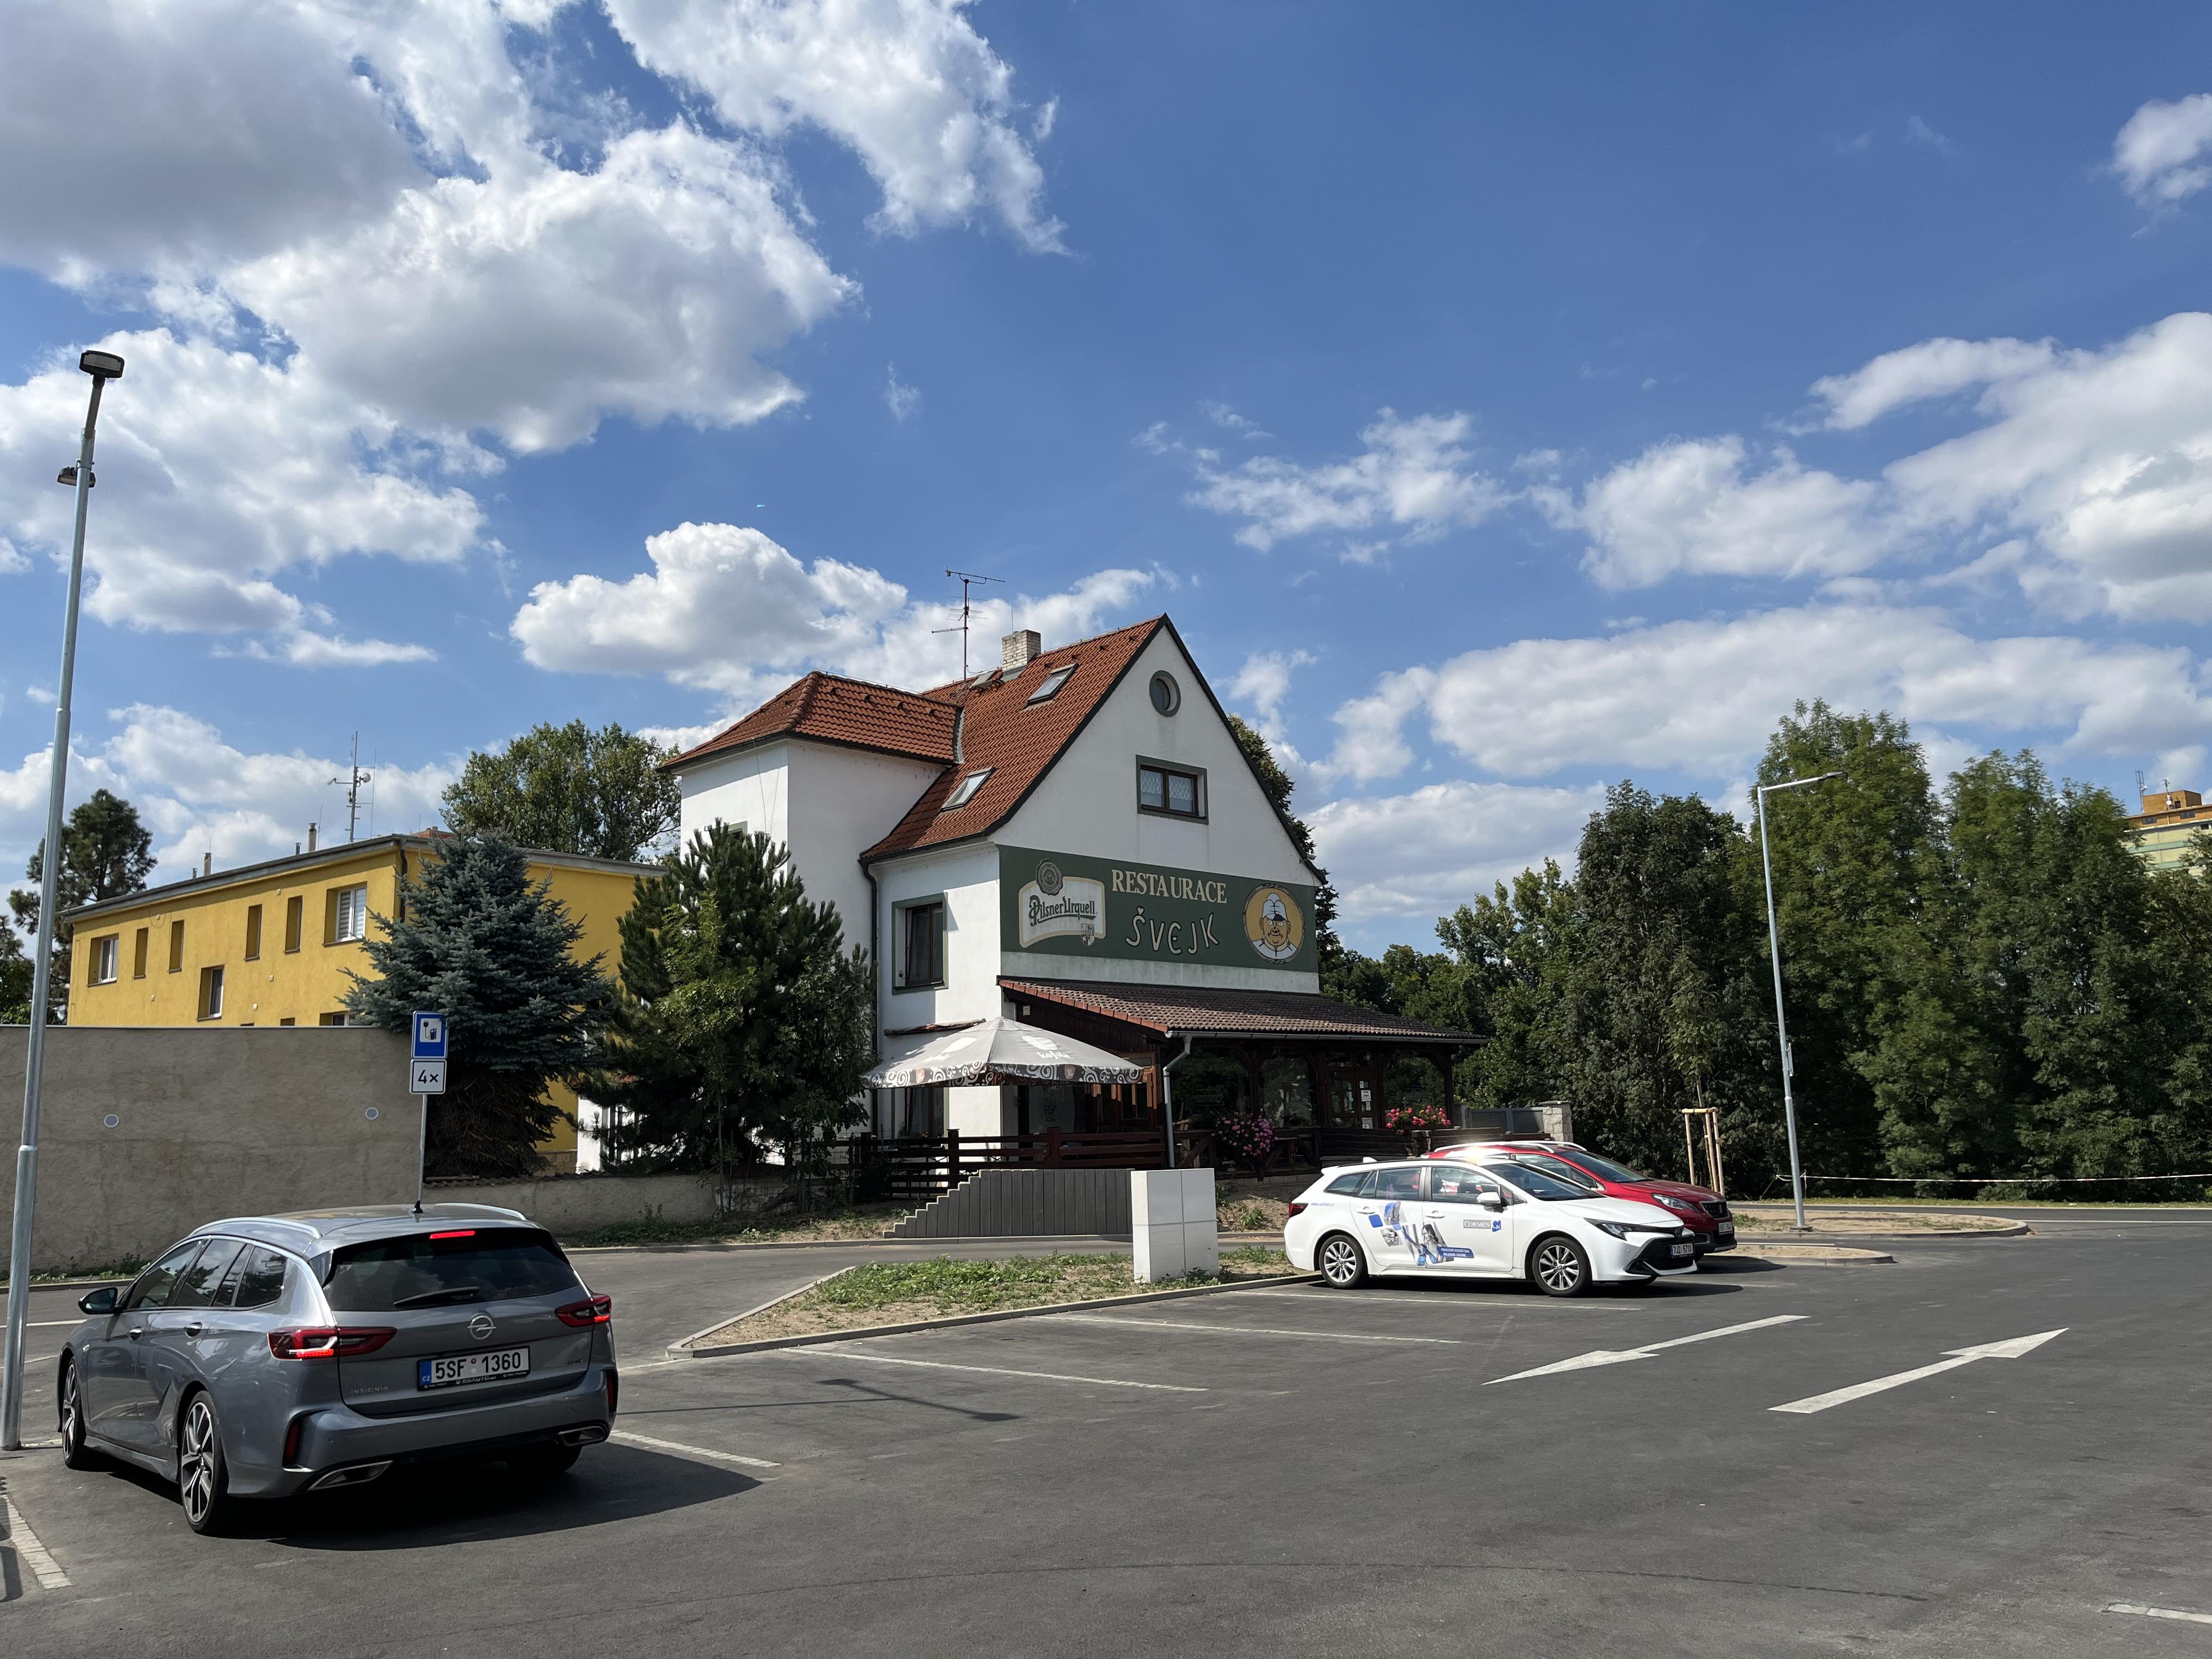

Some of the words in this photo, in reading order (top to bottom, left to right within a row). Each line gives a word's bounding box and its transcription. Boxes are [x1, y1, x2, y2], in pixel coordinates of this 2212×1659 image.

[1112, 869, 1227, 904] RESTAURACE
[1029, 895, 1063, 926] Pilsner
[1062, 896, 1095, 921] Urquell
[1125, 906, 1219, 954] ŠVEJK
[435, 1359, 467, 1379] 5SF
[482, 1352, 521, 1373] 1360
